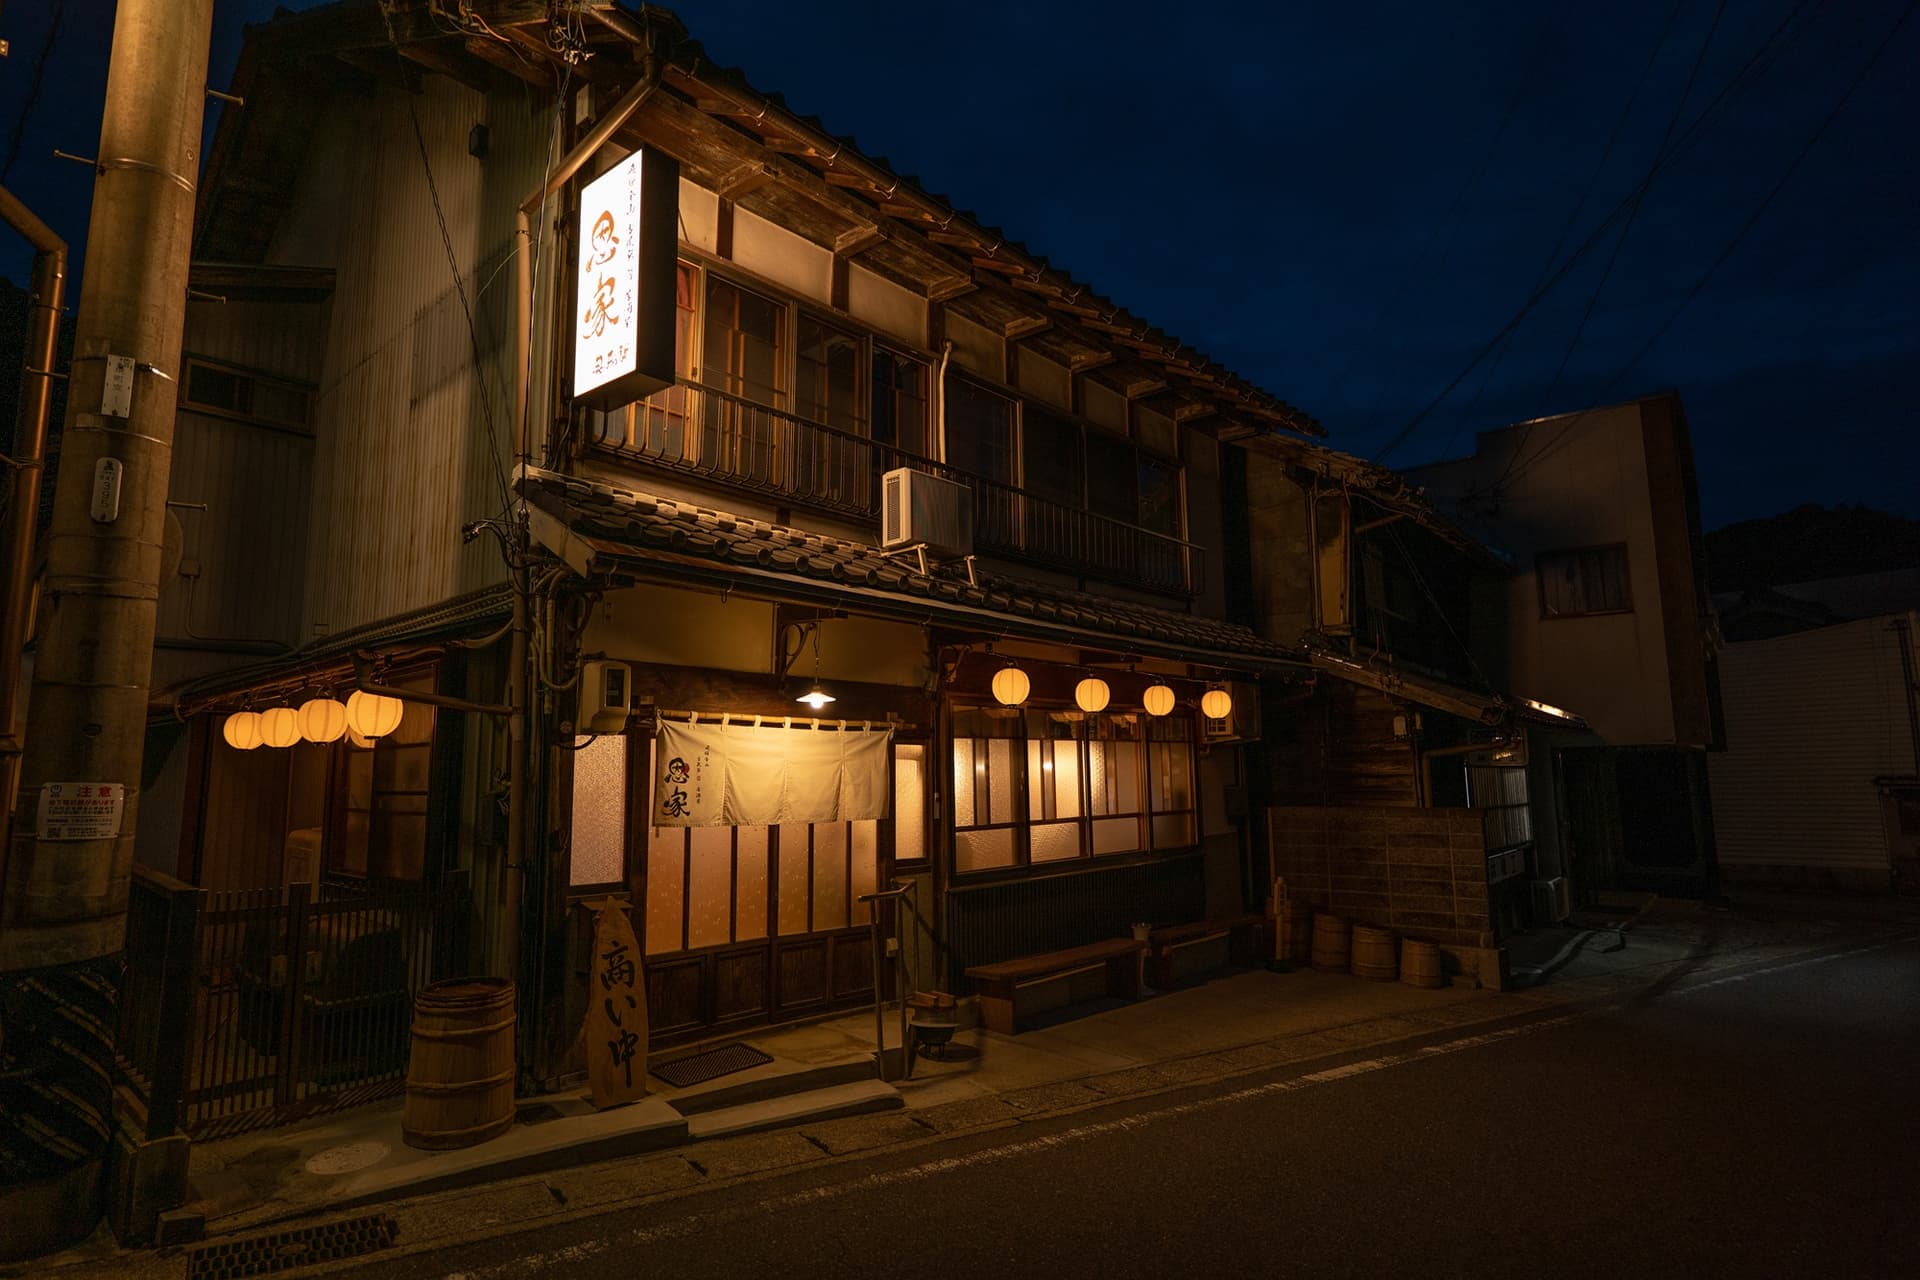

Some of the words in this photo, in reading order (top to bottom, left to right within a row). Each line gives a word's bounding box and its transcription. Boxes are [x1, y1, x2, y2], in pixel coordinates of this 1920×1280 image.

[582, 210, 620, 340] 恩家
[77, 785, 112, 798] 注意
[663, 757, 690, 817] 恩家
